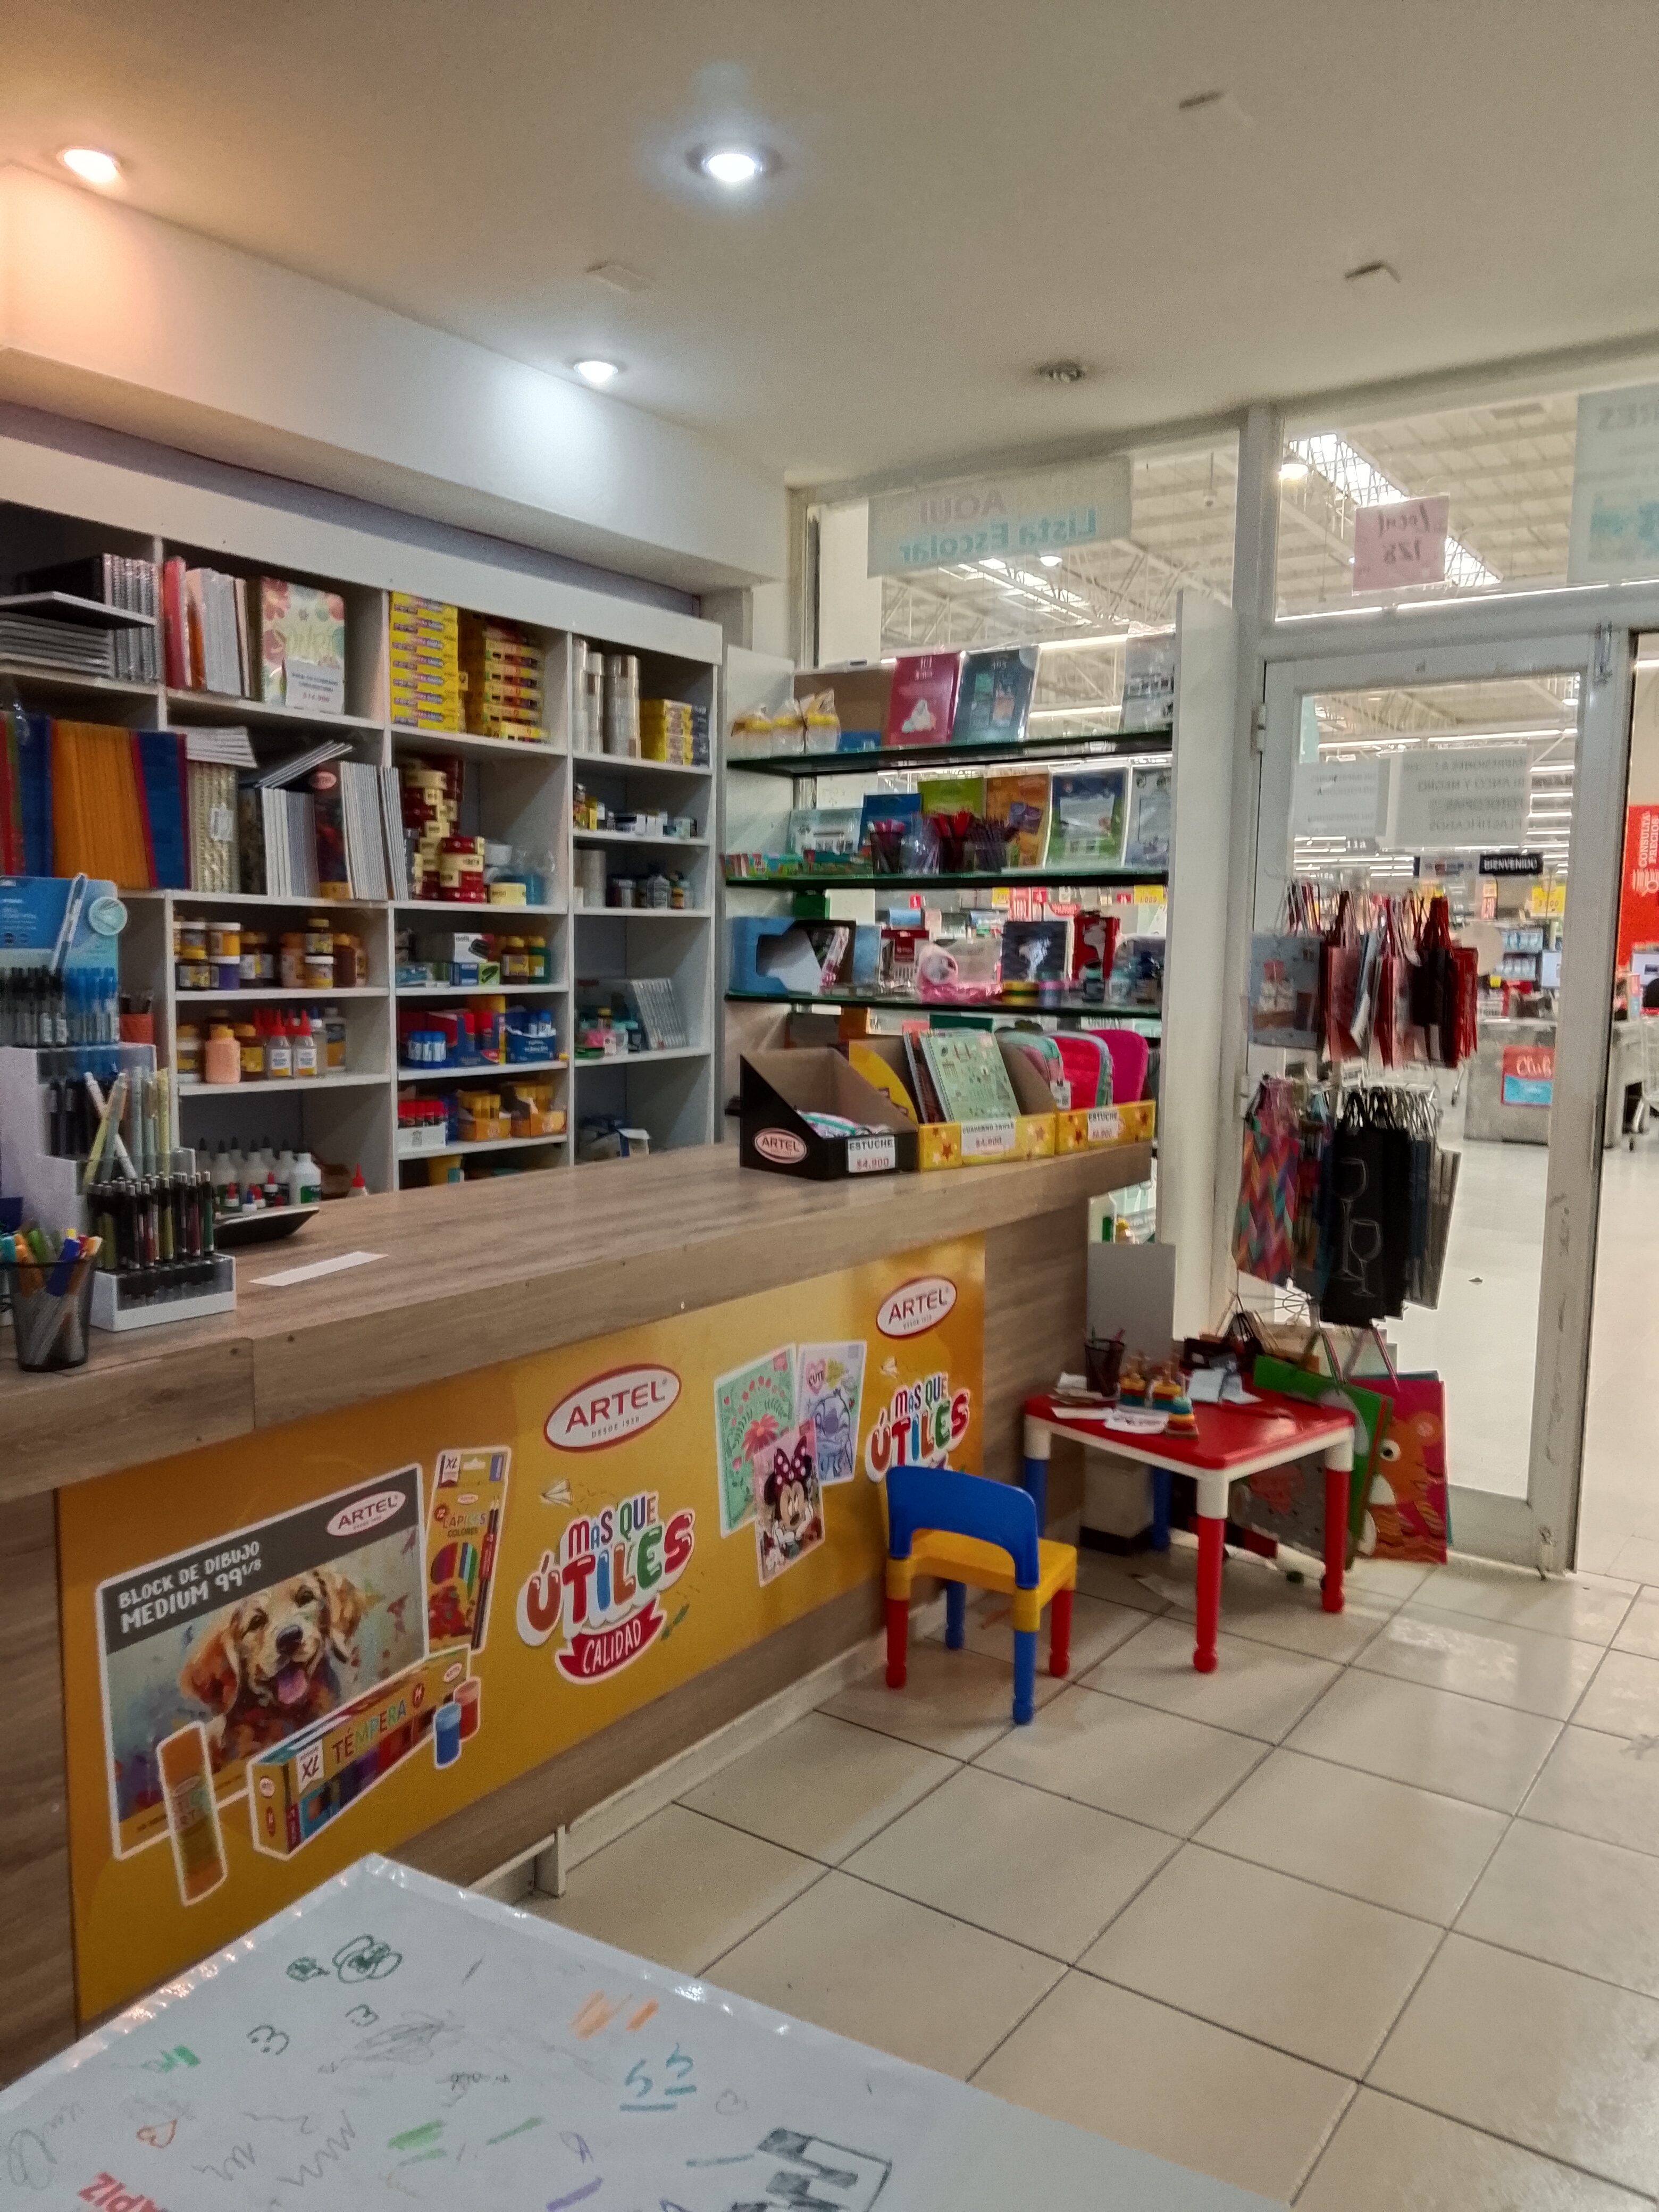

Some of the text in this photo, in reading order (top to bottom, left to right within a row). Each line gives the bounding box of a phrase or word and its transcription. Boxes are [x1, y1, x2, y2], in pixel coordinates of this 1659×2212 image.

[1638, 811, 1650, 868] CONSULTA
[1648, 816, 1659, 865] PRECIOS
[1484, 857, 1537, 871] BIENVENIDO
[762, 1137, 800, 1153] ARTEL
[850, 1138, 893, 1152] ESTUCHE
[962, 1123, 994, 1135] CUADERNO
[888, 1288, 948, 1325] ARTEL
[565, 1381, 665, 1435] ARTEL
[925, 1375, 948, 1410] QUE
[591, 1423, 618, 1438] DESDE
[871, 1393, 968, 1472] ÚTILES
[446, 1456, 458, 1470] XL
[338, 1496, 398, 1529] ARTEL
[619, 1495, 656, 1540] QUE
[119, 1541, 260, 1609] BLOCK DE DIBUJO
[526, 1513, 692, 1631] ÚTILES
[120, 1580, 209, 1634] MEDIUM
[584, 1618, 642, 1674] CALIDAD
[331, 1699, 406, 1764] TÉMPERA
[301, 1754, 320, 1783] XL
